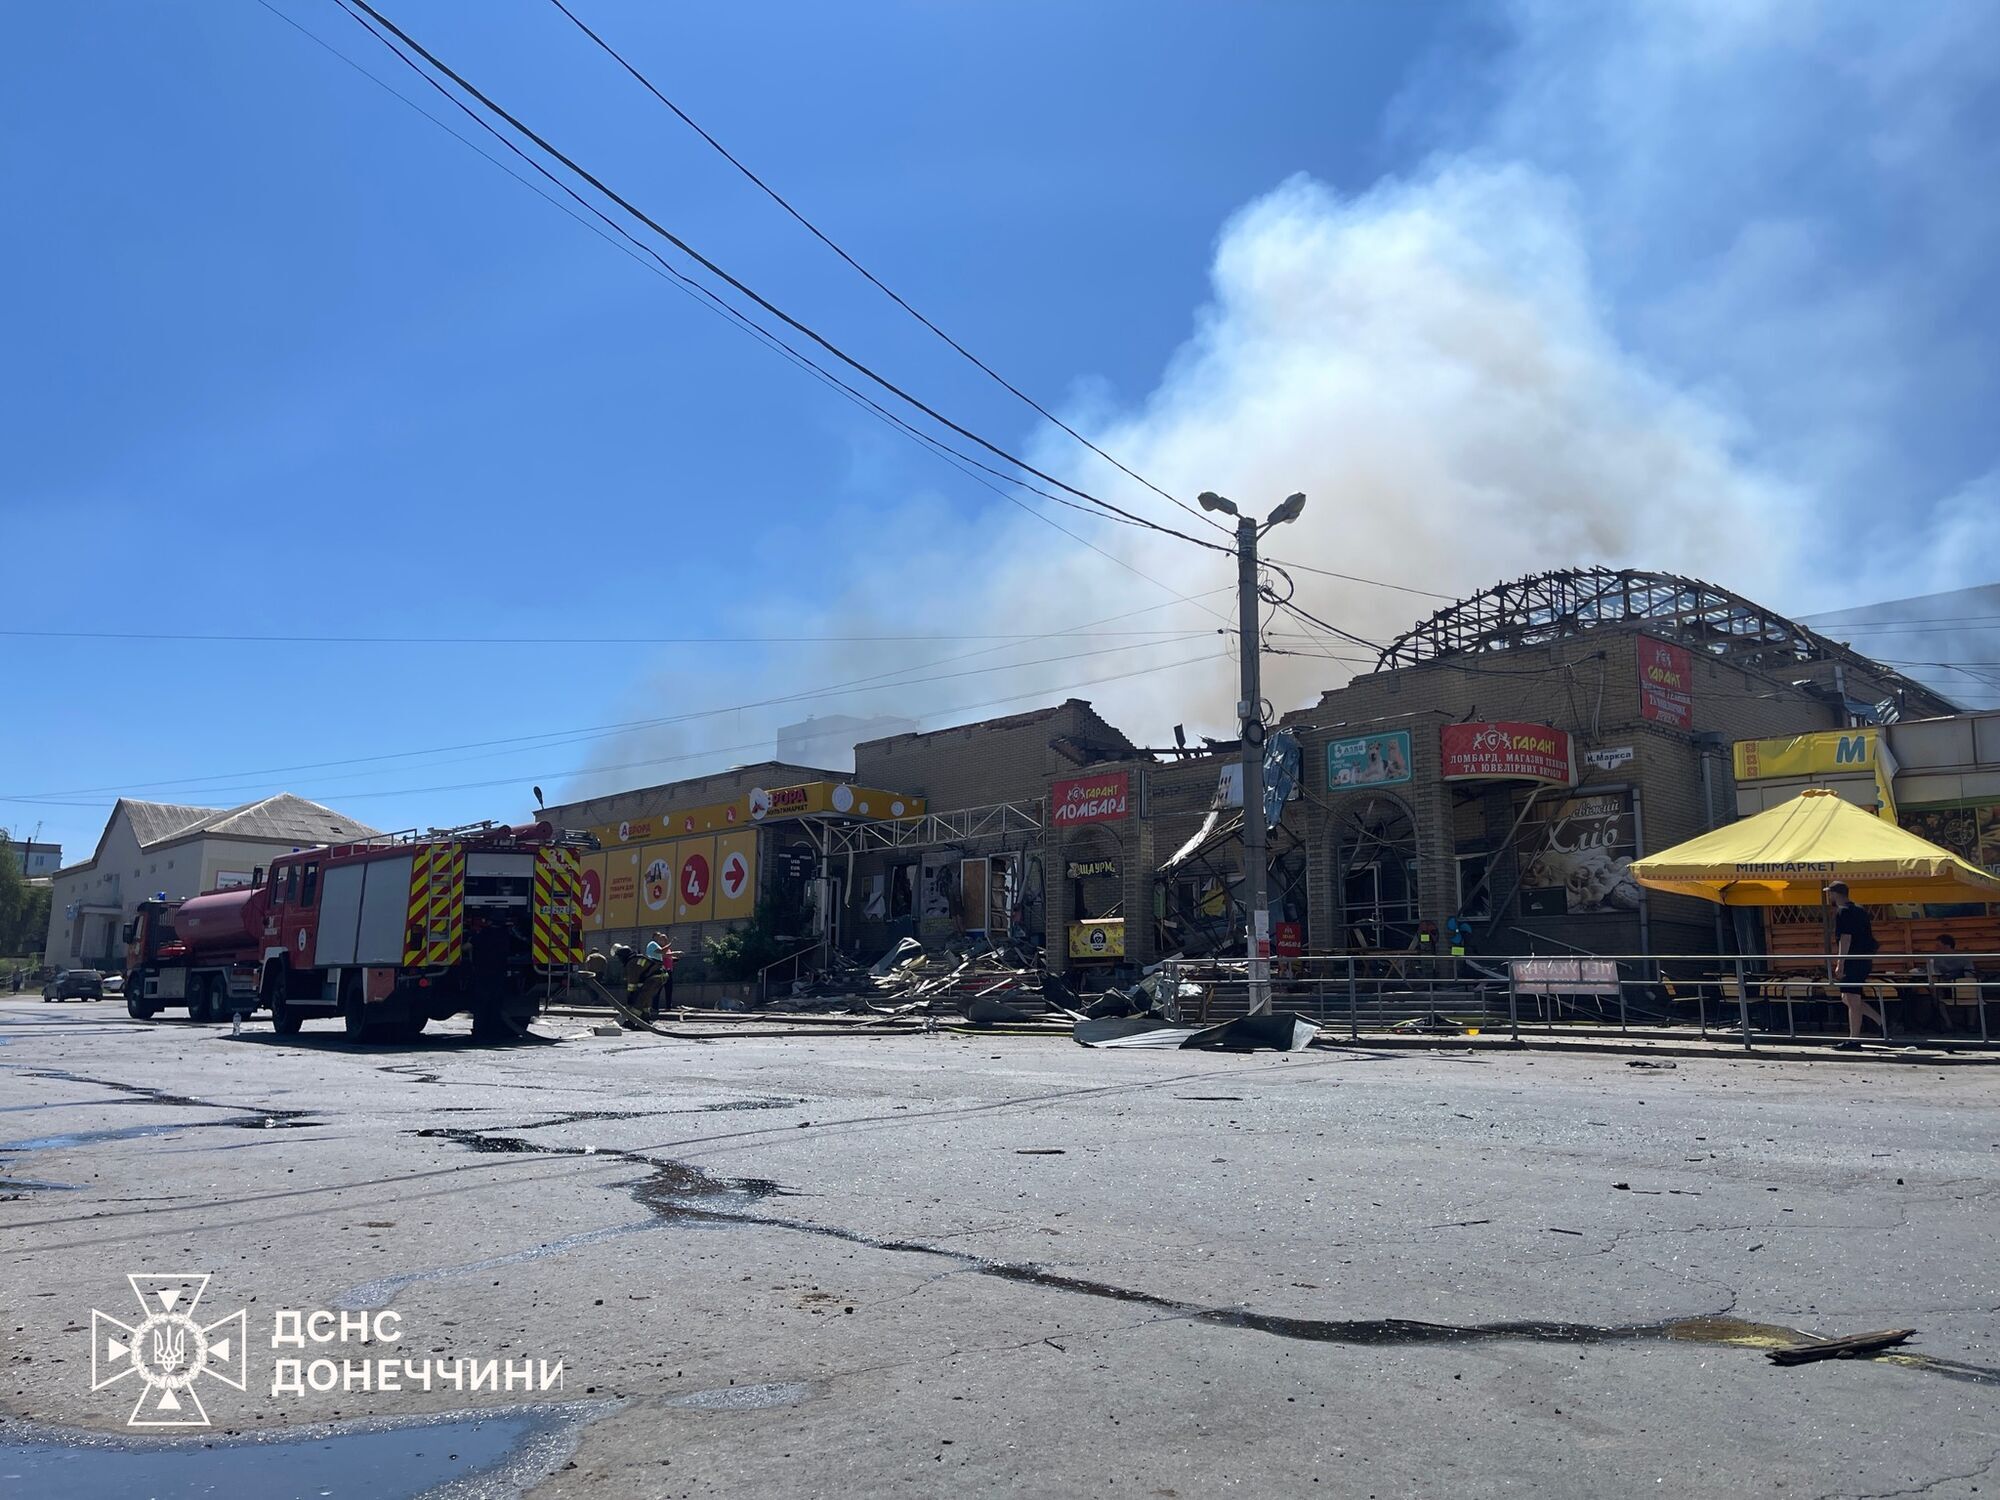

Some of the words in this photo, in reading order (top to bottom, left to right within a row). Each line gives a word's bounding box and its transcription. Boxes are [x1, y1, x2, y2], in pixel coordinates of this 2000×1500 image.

[1648, 665, 1680, 688] ГАРАНТ
[1512, 735, 1556, 755] ГАРАНТ
[1836, 736, 1868, 764] М
[1463, 764, 1476, 773] ТА
[1481, 763, 1537, 774] ЮВЕЛІРНИХ
[1505, 753, 1544, 766] МАГАЗИН
[1086, 784, 1119, 800] ГАРАНТ
[1055, 796, 1126, 820] ЛОМБАРД
[1533, 814, 1621, 860] Хліб
[1736, 862, 1837, 874] МІНІМАРКЕТ
